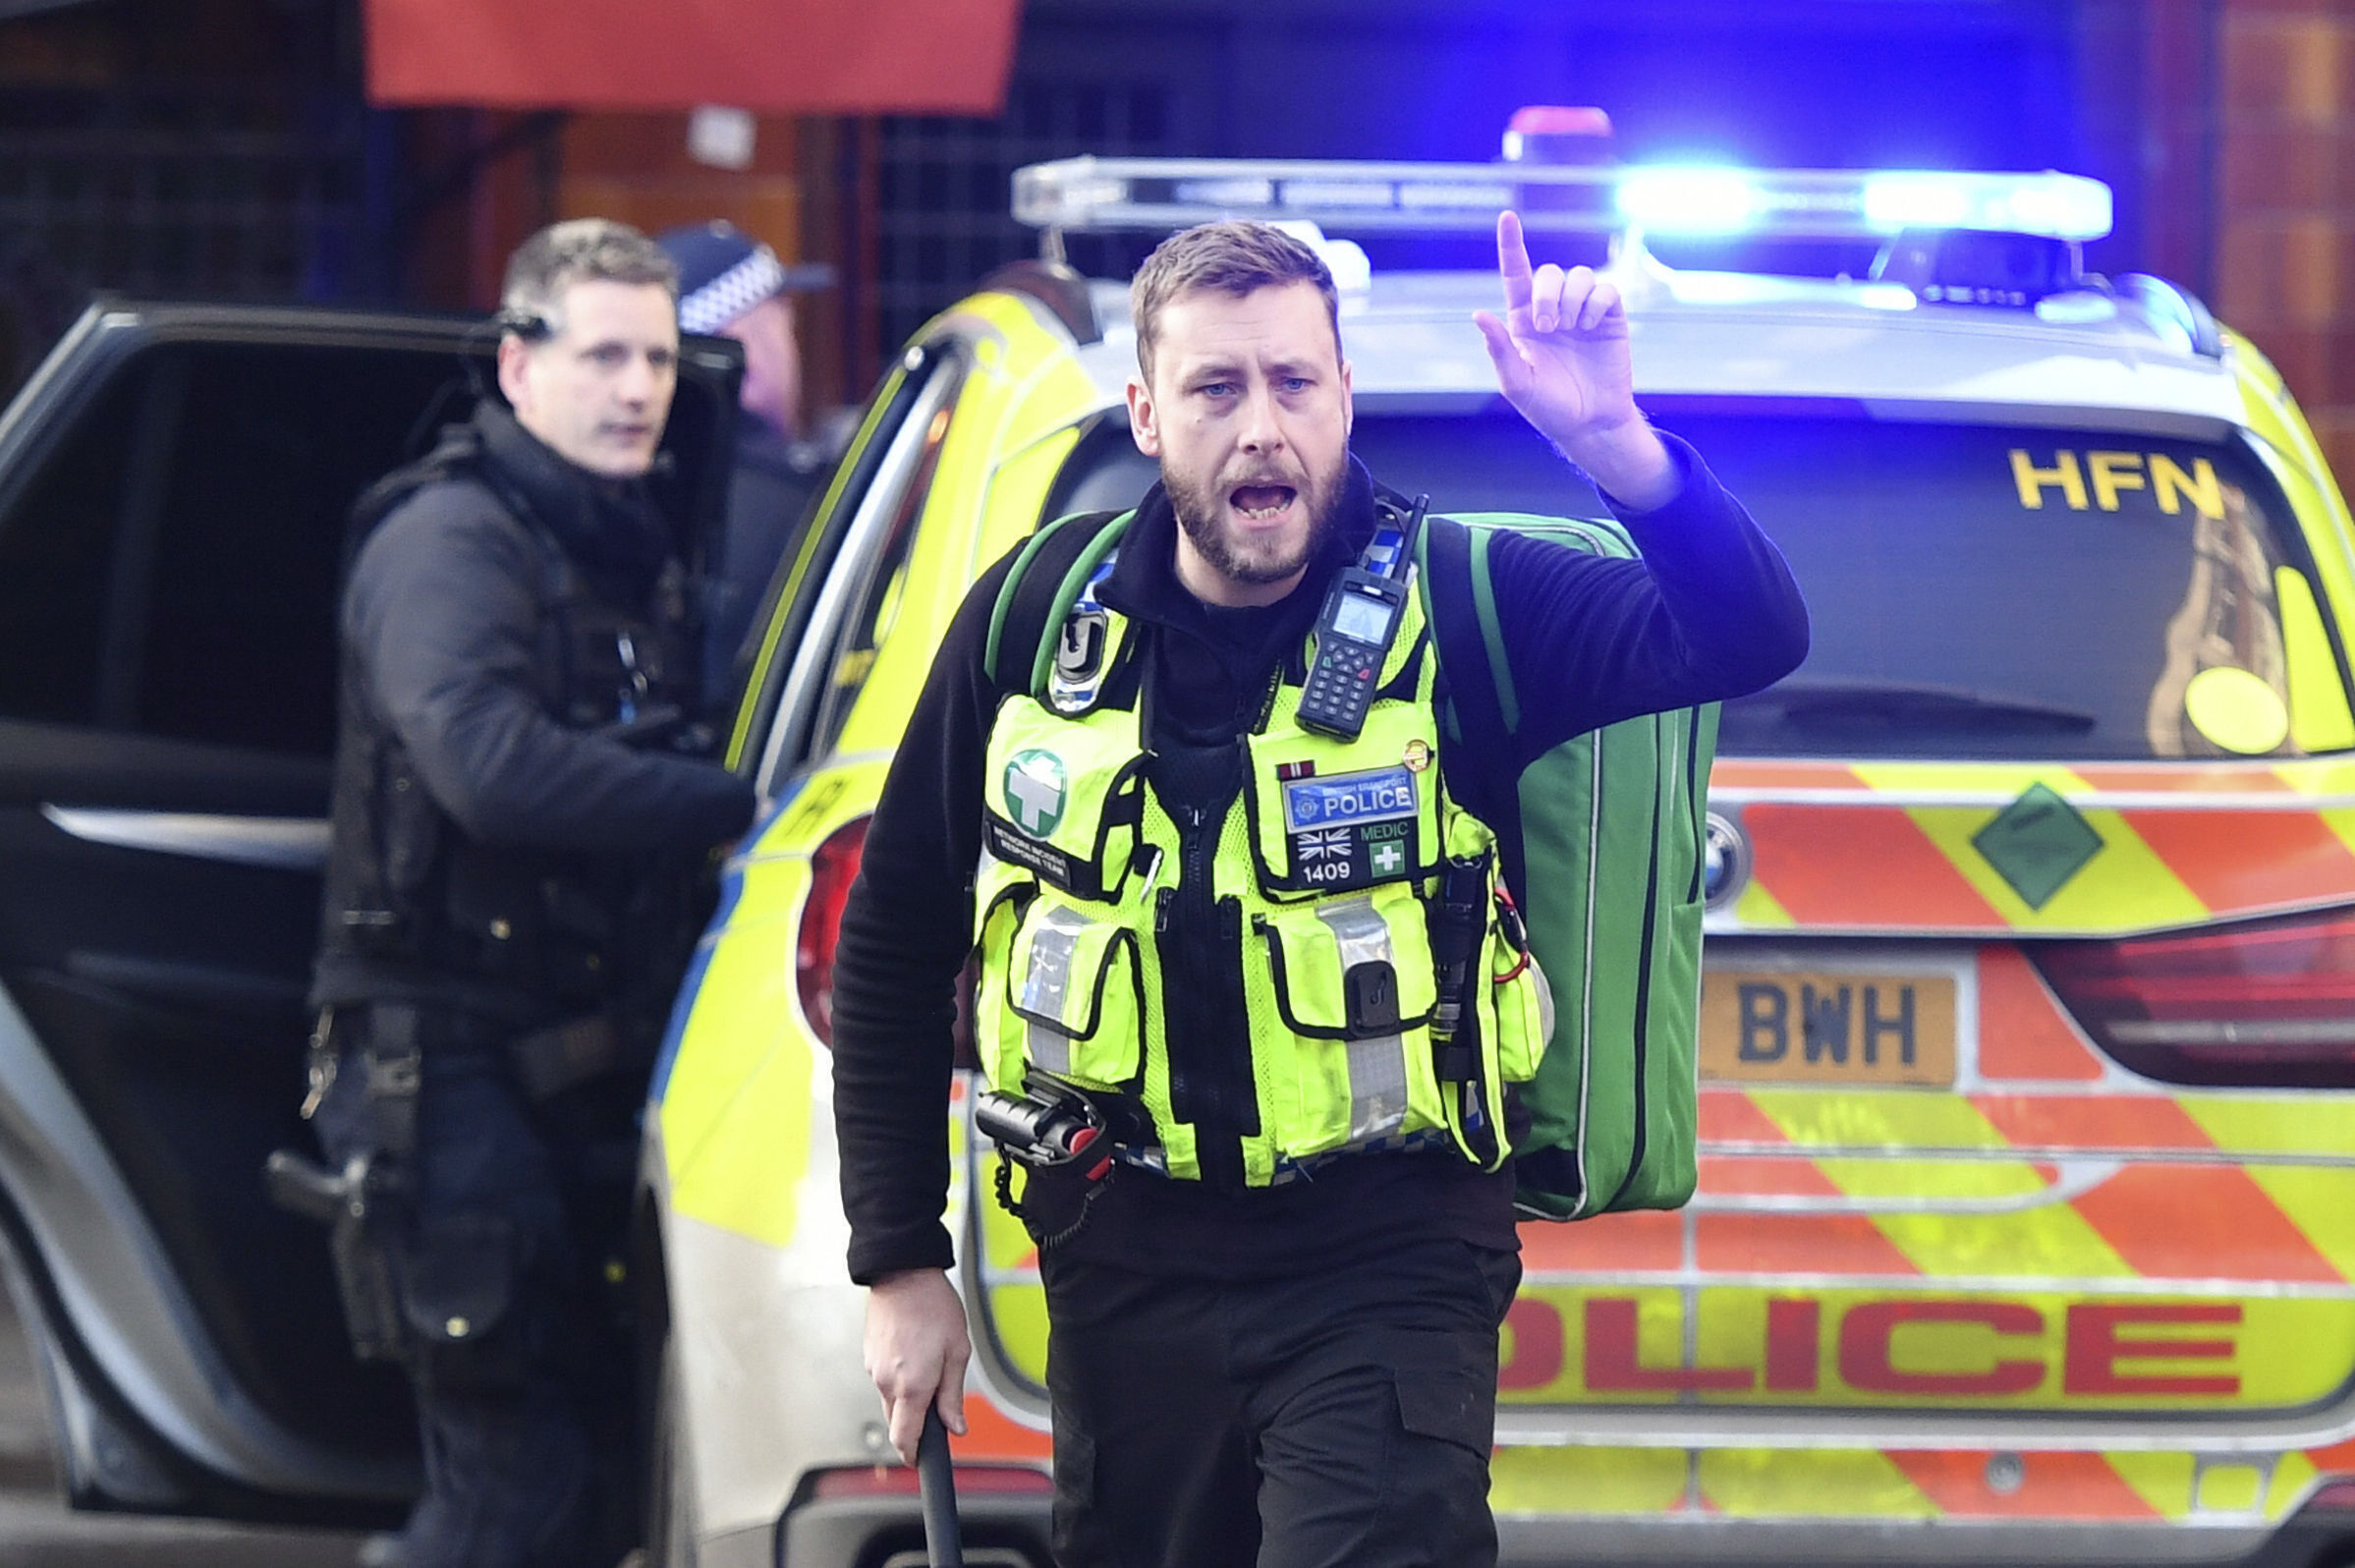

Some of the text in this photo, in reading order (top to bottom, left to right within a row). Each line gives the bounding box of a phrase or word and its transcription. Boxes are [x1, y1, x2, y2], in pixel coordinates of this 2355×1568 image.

[2008, 448, 2225, 520] HFN
[1323, 787, 1412, 816] POLICE
[1361, 821, 1408, 840] MEDIC
[1041, 859, 1064, 876] TEAM
[1304, 862, 1351, 882] 1409
[1739, 983, 1915, 1065] BWH
